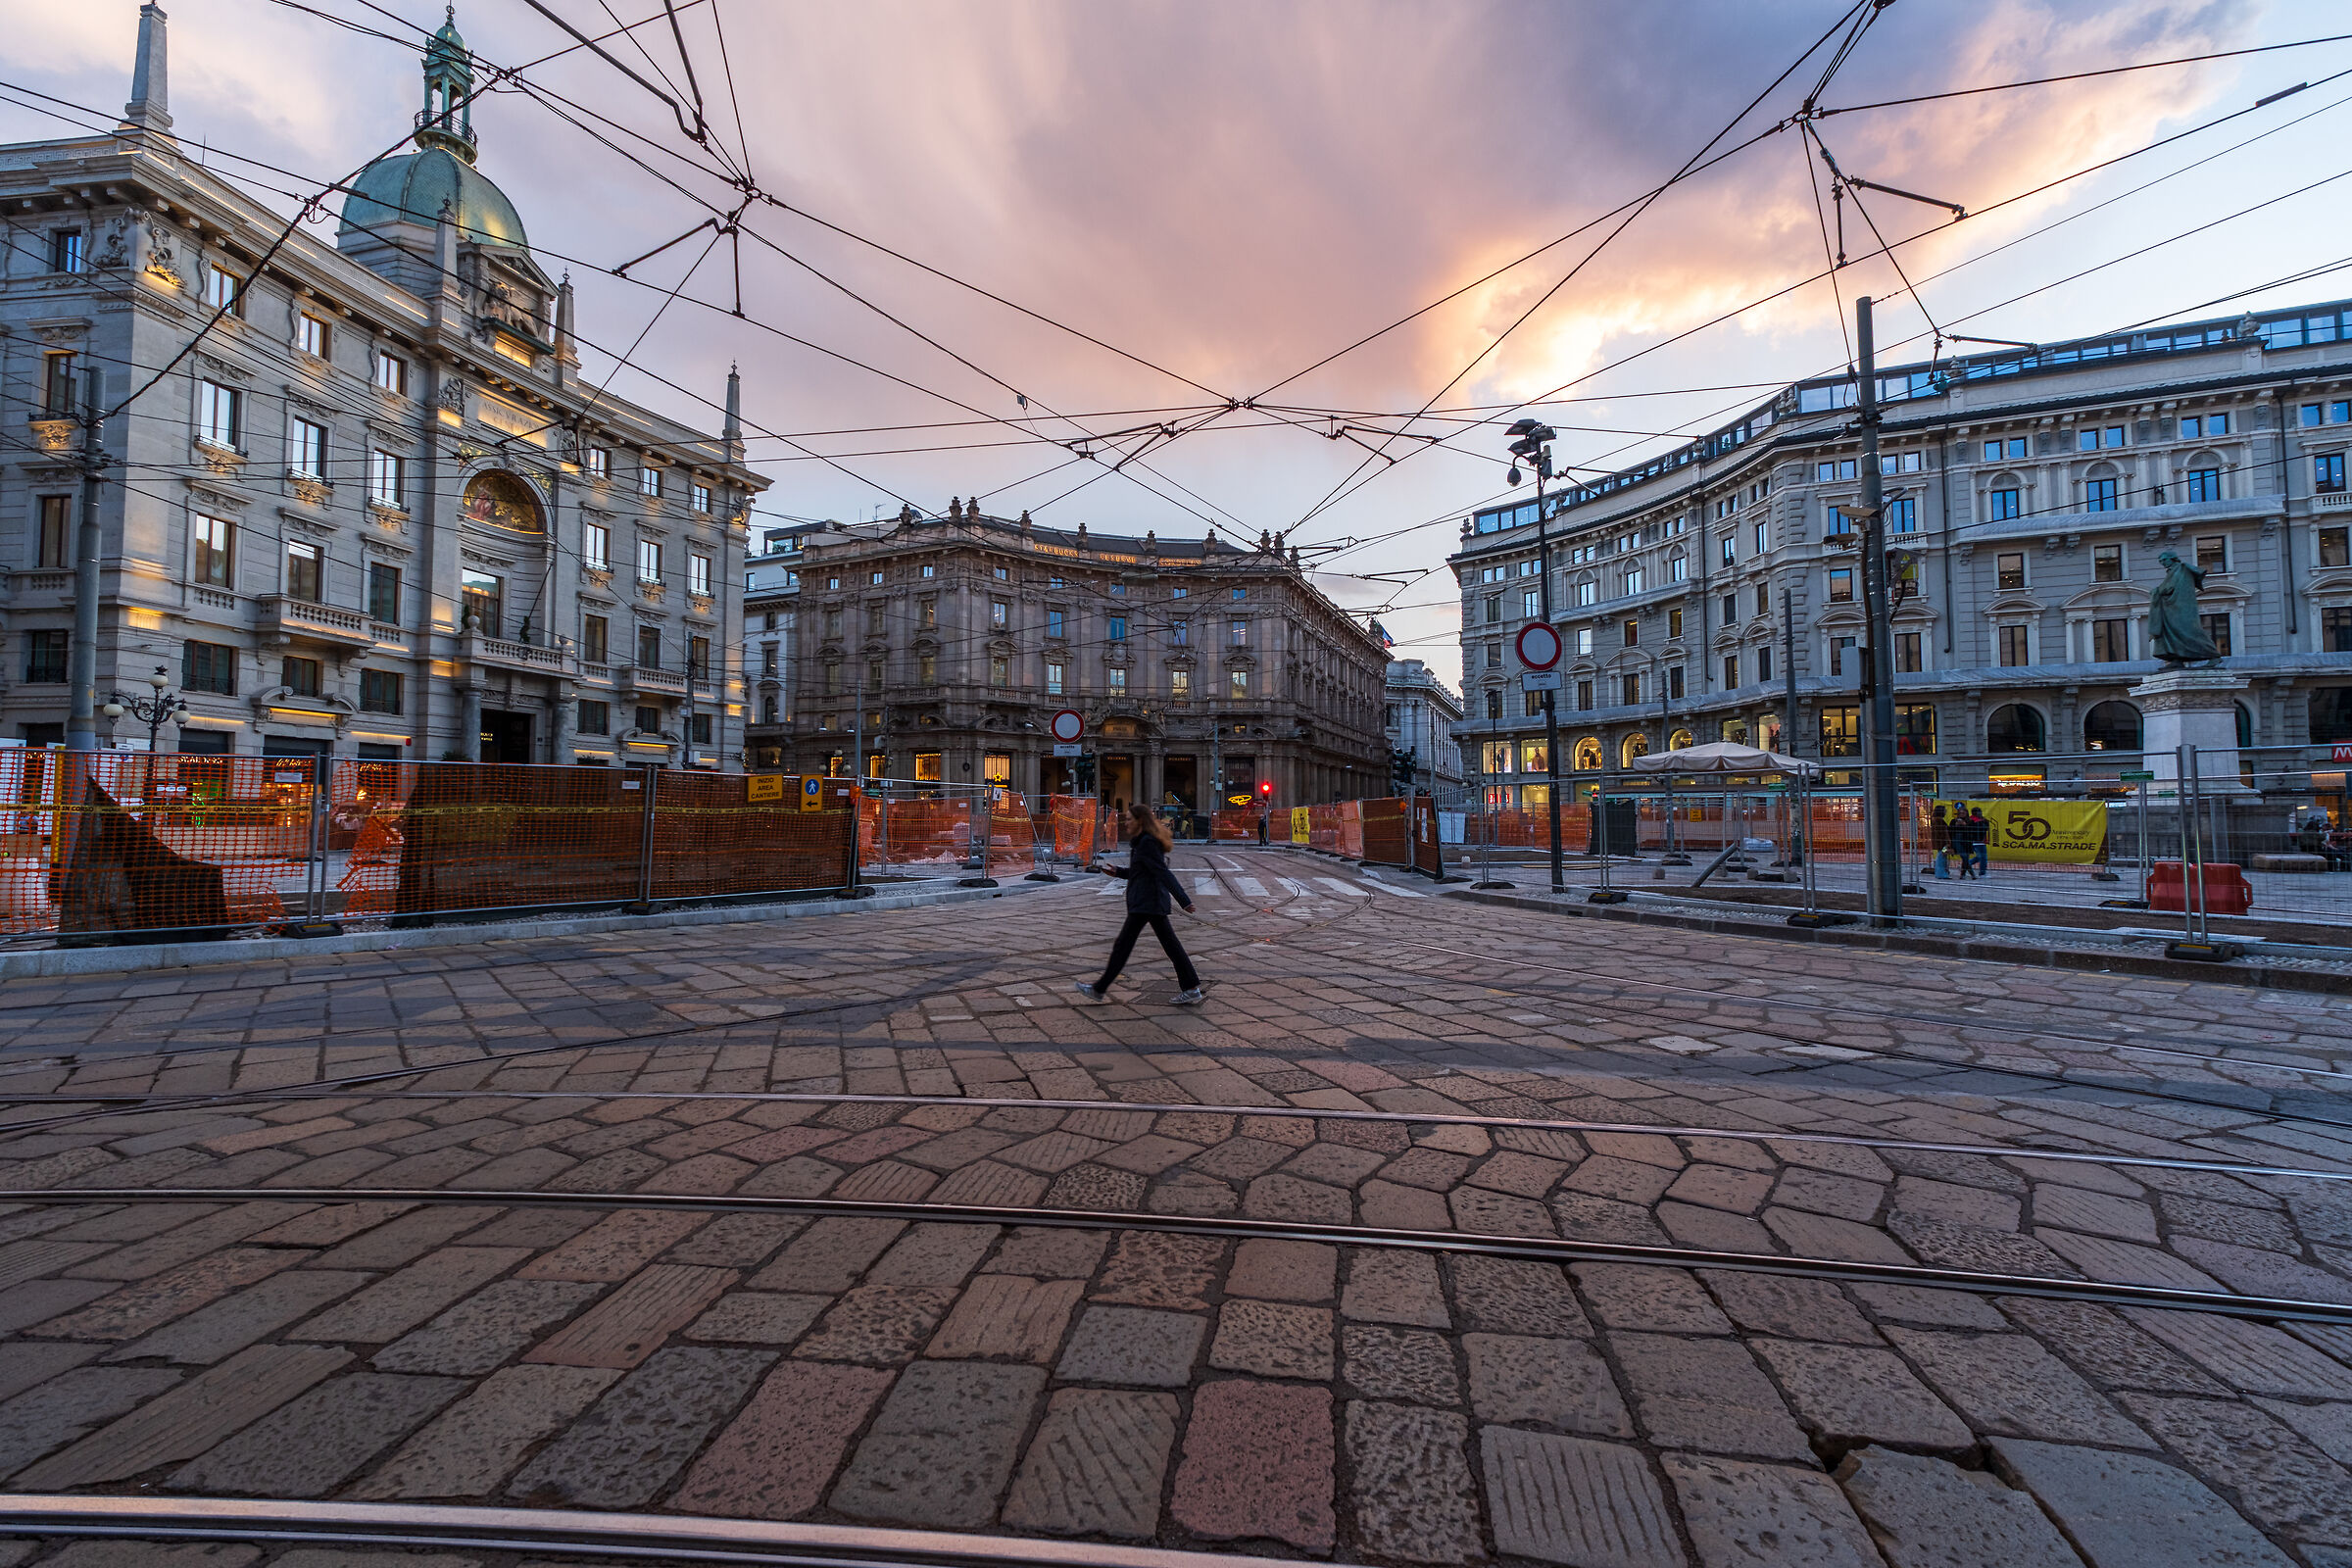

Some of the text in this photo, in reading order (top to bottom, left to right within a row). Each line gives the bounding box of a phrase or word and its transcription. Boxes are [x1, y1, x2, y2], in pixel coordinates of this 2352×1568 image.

[1034, 544, 1079, 558] STARBUCKS
[2005, 811, 2051, 841] 50
[2001, 841, 2097, 851] SCA.MA.STRADE
